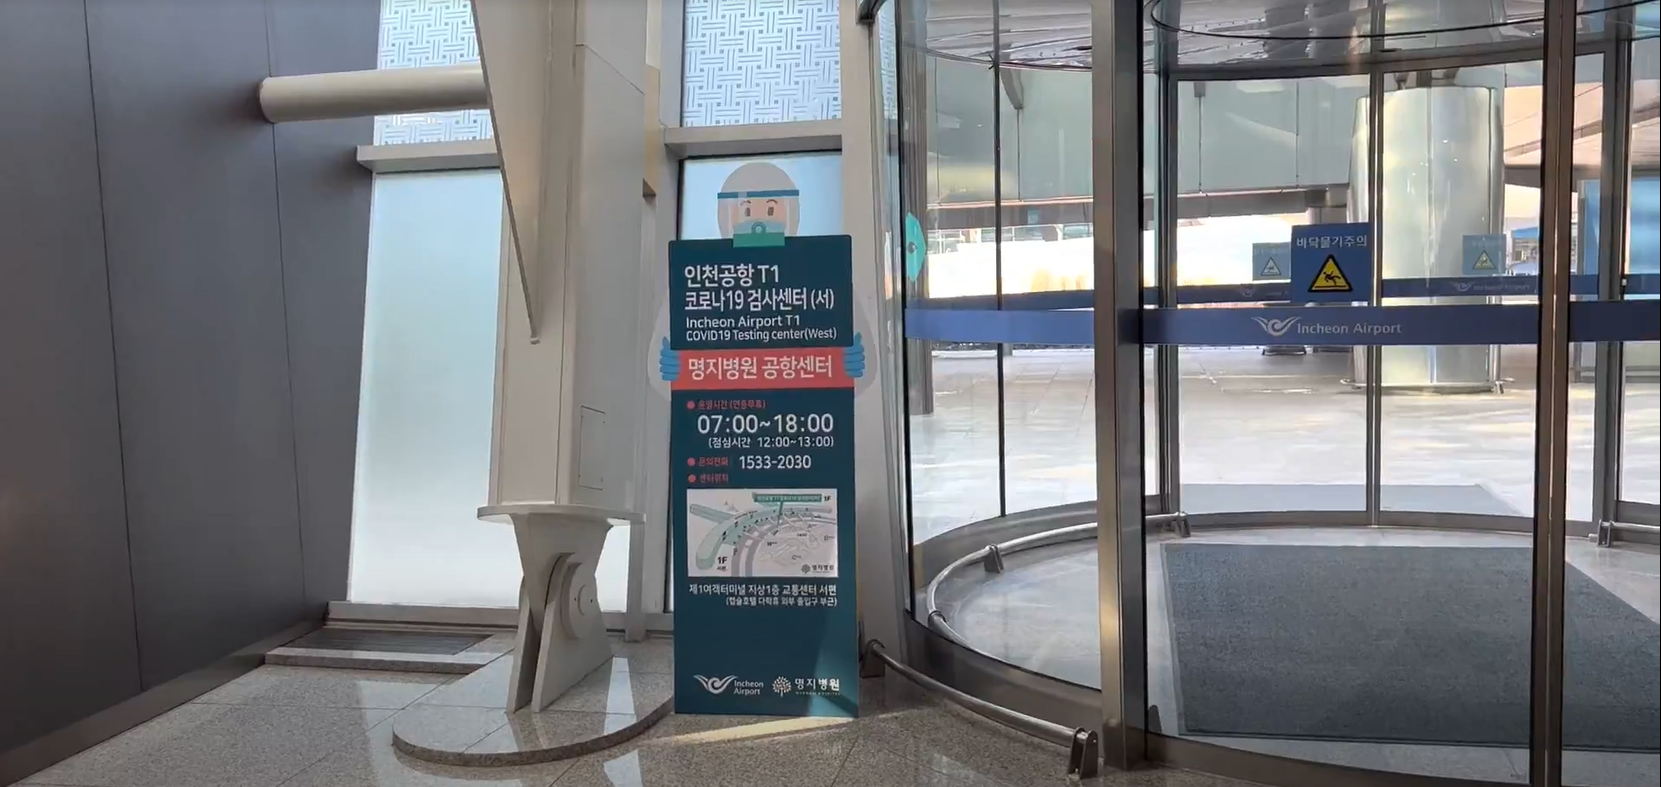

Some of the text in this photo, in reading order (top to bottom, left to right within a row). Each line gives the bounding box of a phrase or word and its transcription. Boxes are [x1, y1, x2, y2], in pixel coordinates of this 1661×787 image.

[1295, 234, 1368, 249] 바닥물기주의
[684, 263, 780, 287] 인천공항 T1
[684, 288, 834, 311] 코로나19 검사센터 (서)
[686, 315, 800, 330] Incheon Airport T1
[1297, 321, 1402, 338] Incheon Airport
[686, 327, 837, 343] COVID19 Testing center(West)
[688, 355, 833, 381] 명지병원 공항센터
[697, 413, 834, 434] 07:00~18:00
[708, 436, 834, 449] (점심시간 12:00~13:00)
[739, 455, 812, 470] 1533-2030
[717, 556, 728, 565] 1F
[689, 584, 746, 596] 제1여객터미널
[733, 679, 764, 689] Incheon
[733, 687, 761, 696] Airport
[794, 678, 840, 692] 명지병원
